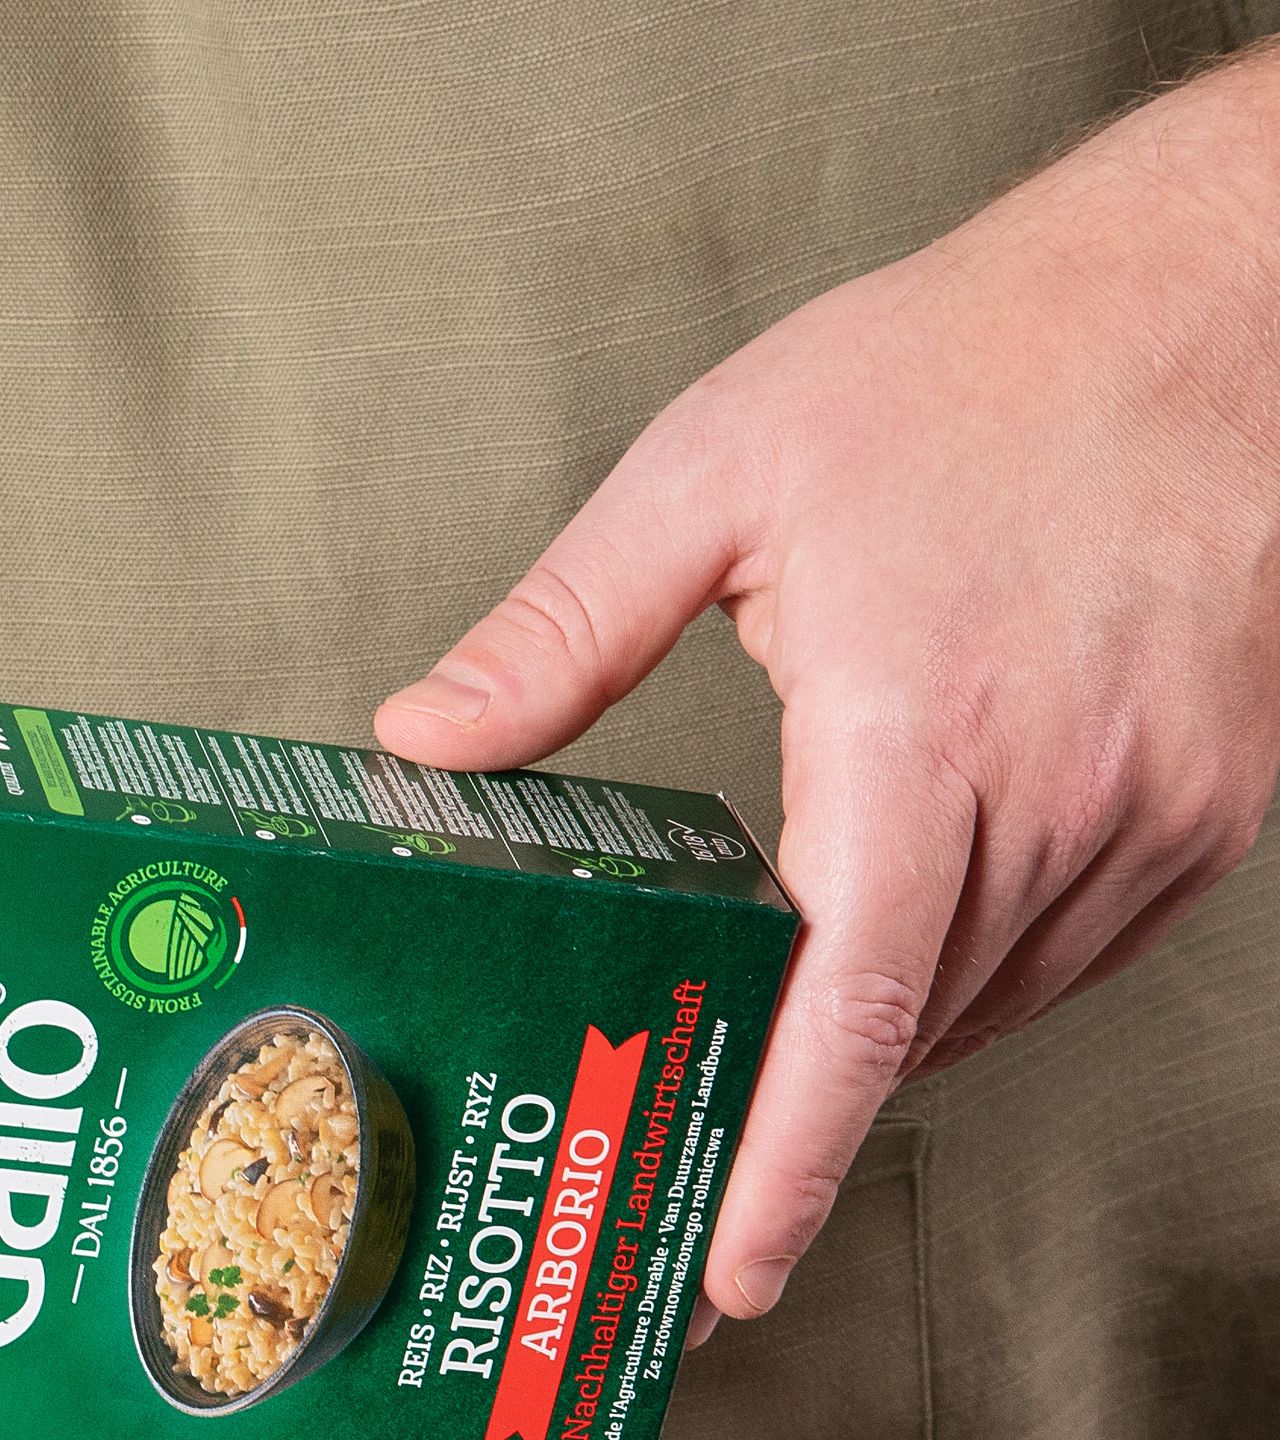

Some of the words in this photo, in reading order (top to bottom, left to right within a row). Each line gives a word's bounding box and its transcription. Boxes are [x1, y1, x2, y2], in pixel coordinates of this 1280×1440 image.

[107, 860, 229, 907] AGRICULTURE
[90, 902, 147, 1010] SUSTAINABLE
[147, 992, 204, 1015] FROM
[615, 979, 707, 1231] Landwirtschaft
[691, 1018, 729, 1109] Landbouw
[86, 1116, 128, 1187] 1856
[667, 1111, 705, 1200] Duurzame
[691, 1127, 725, 1209] rolnictwa
[71, 1194, 112, 1258] DAL
[397, 1323, 435, 1388] REIS
[418, 1253, 454, 1303] RIZ
[436, 1149, 478, 1233] RIJST
[461, 1071, 498, 1130] RYŻ
[438, 1093, 556, 1380] RISOTTO
[520, 1129, 610, 1361] ARBORIO
[658, 1201, 682, 1234] Van
[637, 1246, 670, 1313] Durable
[652, 1211, 704, 1357] zrównoważonego
[608, 1315, 651, 1420] l'Agriculture
[642, 1359, 663, 1380] Ze
